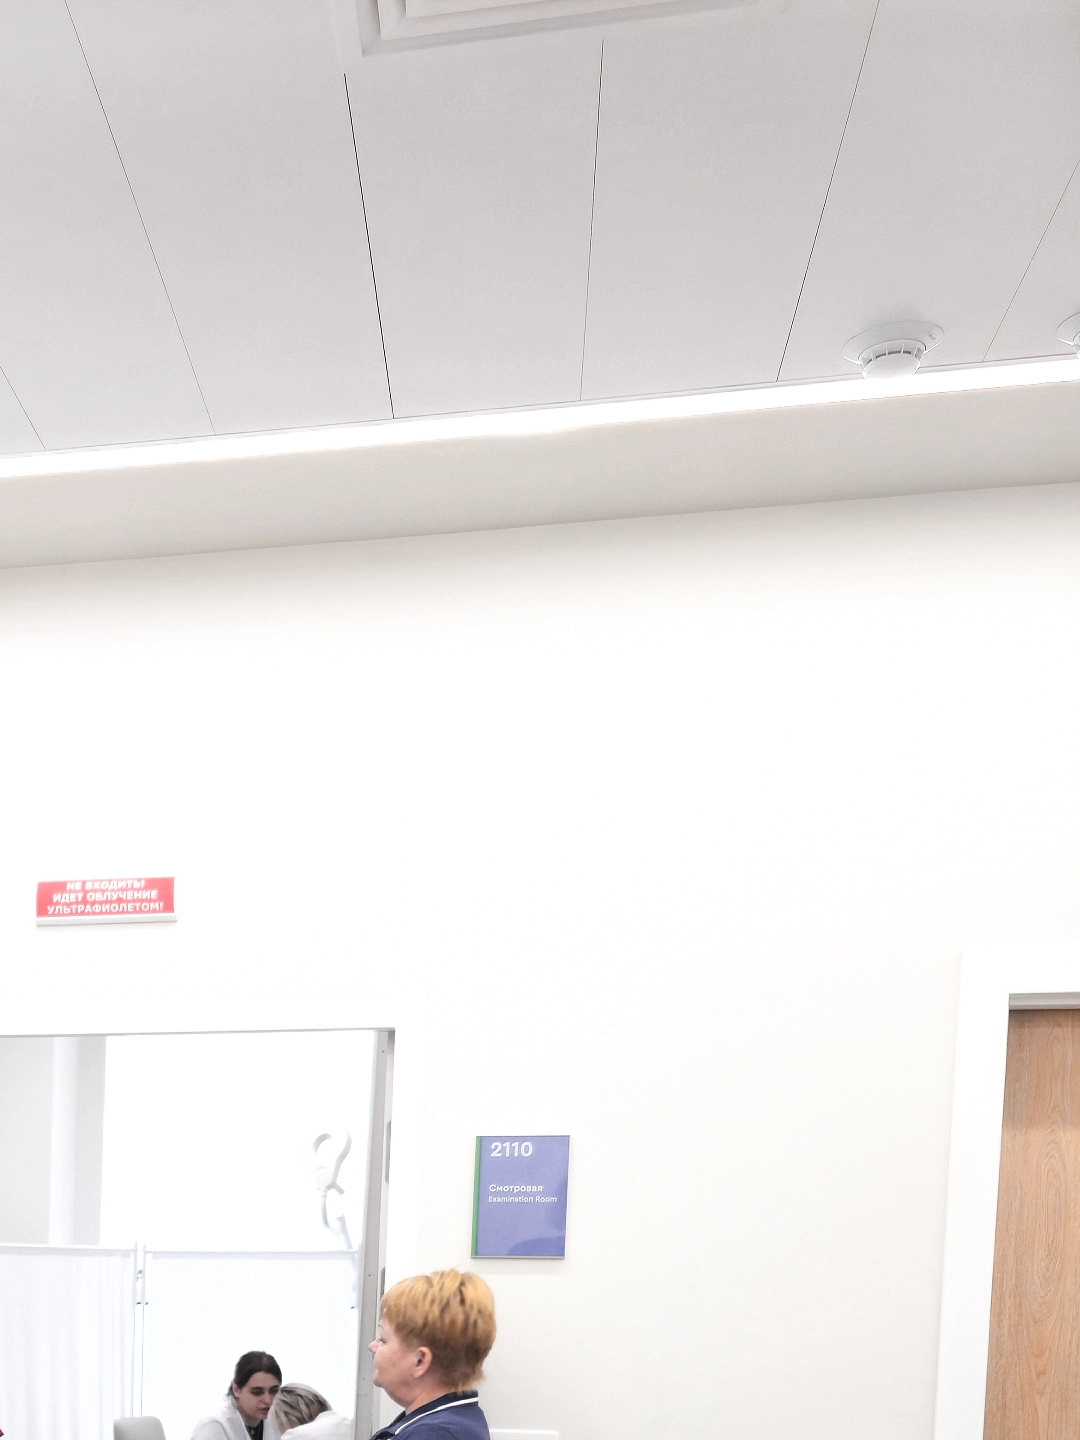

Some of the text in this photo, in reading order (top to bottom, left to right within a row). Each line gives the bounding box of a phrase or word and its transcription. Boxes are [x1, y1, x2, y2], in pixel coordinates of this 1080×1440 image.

[66, 879, 146, 891] НЕ ВХОДИТЬ!
[52, 890, 158, 904] ИДЕТ ОБЛУЧЕНИЕ
[47, 902, 164, 915] УЛЬТРАФИОЛЕТОМ!
[490, 1141, 534, 1158] 2110
[489, 1184, 544, 1194] Смотровая
[488, 1195, 534, 1203] Examination
